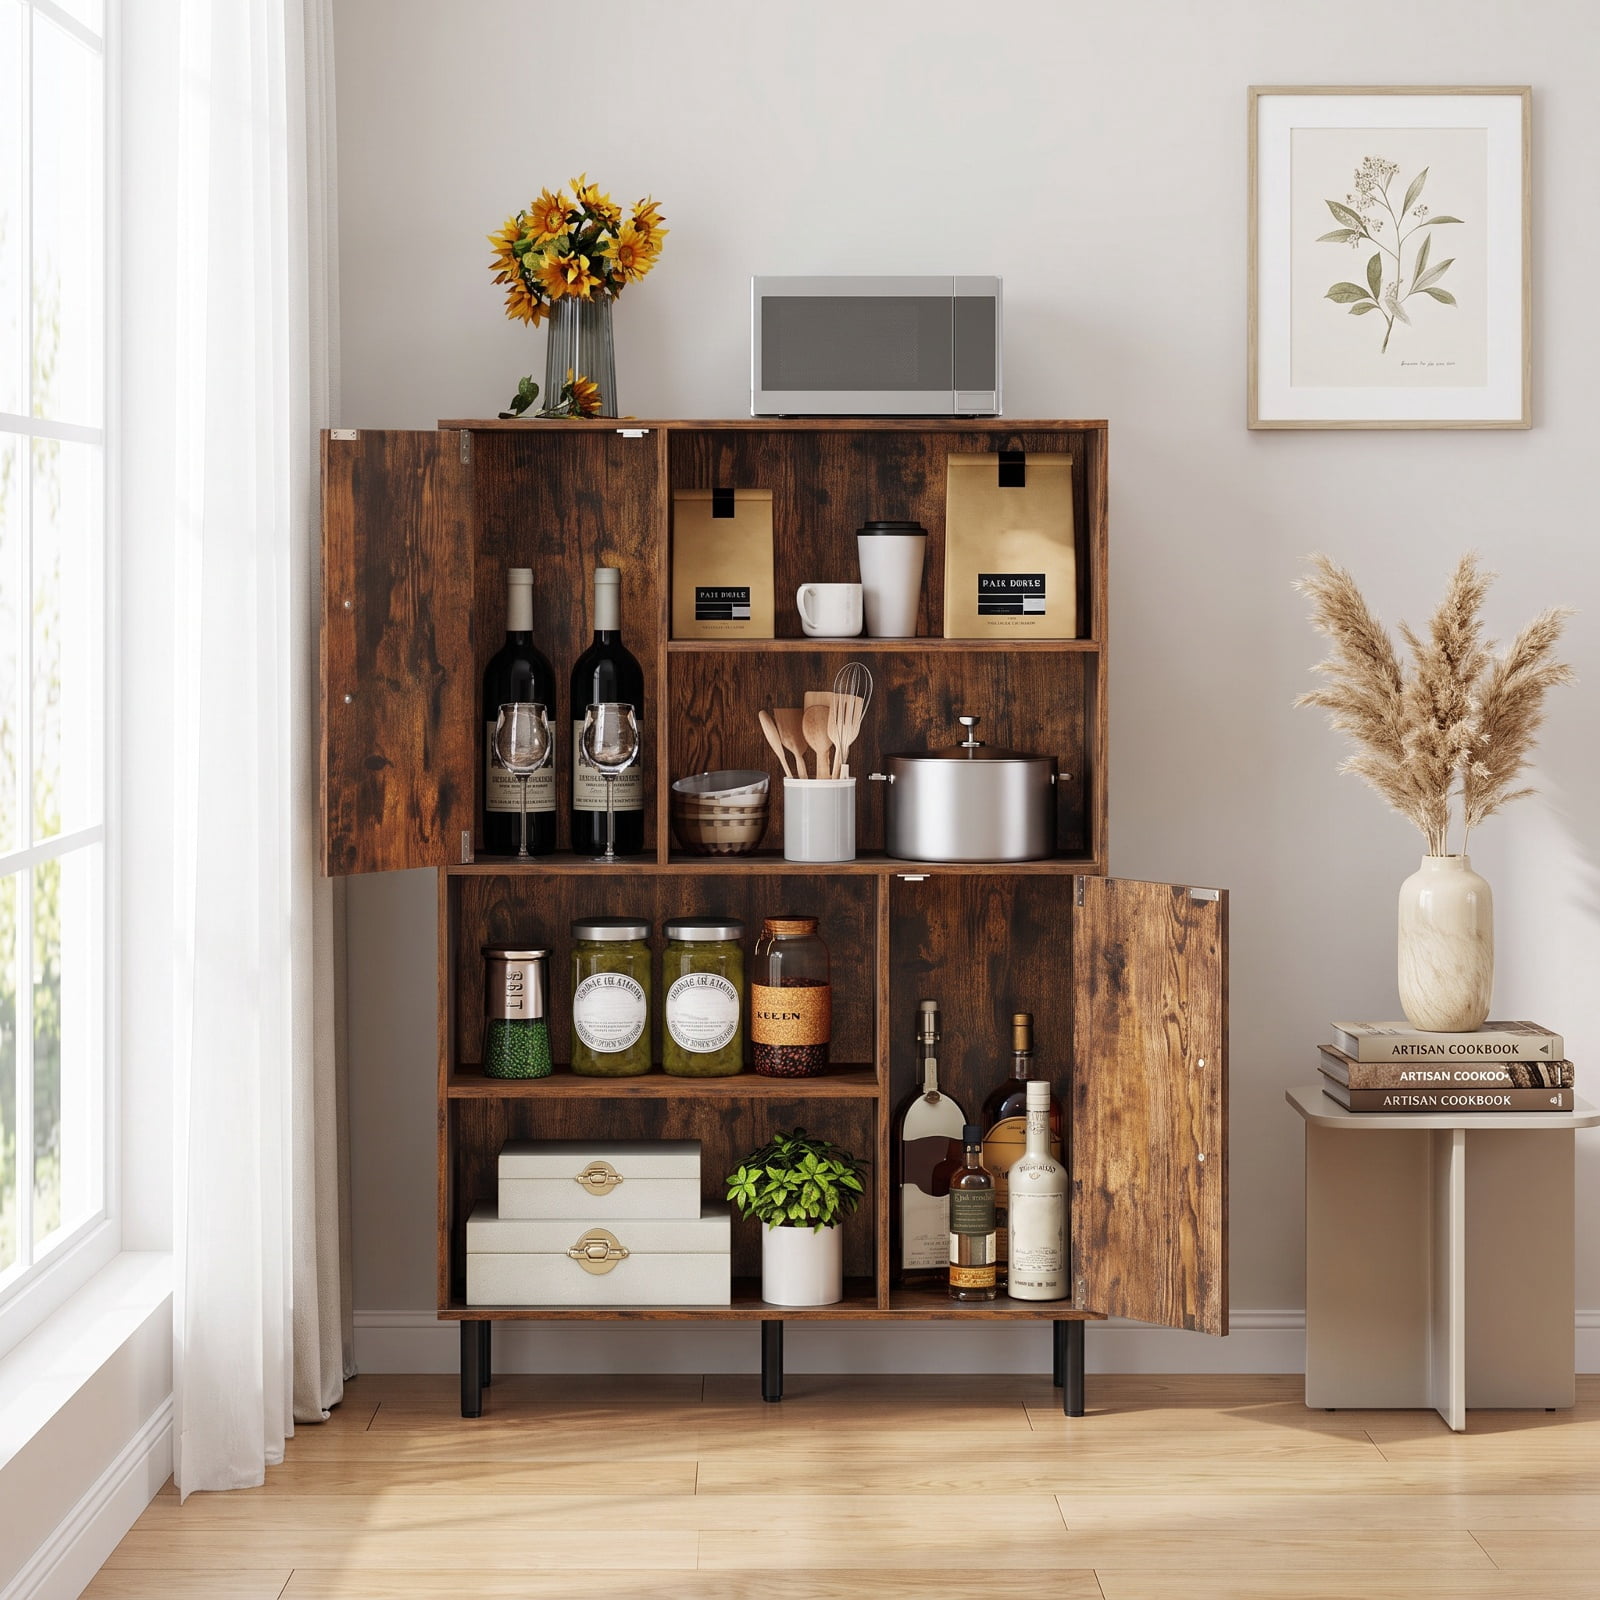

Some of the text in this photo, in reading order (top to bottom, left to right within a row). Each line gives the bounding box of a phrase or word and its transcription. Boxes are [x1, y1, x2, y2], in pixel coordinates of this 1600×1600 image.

[1392, 1044, 1520, 1055] ARTISAN COOKBOOK
[1400, 1071, 1450, 1081] ARTISAN
[1383, 1095, 1512, 1106] ARTISAN COOKBOOK
